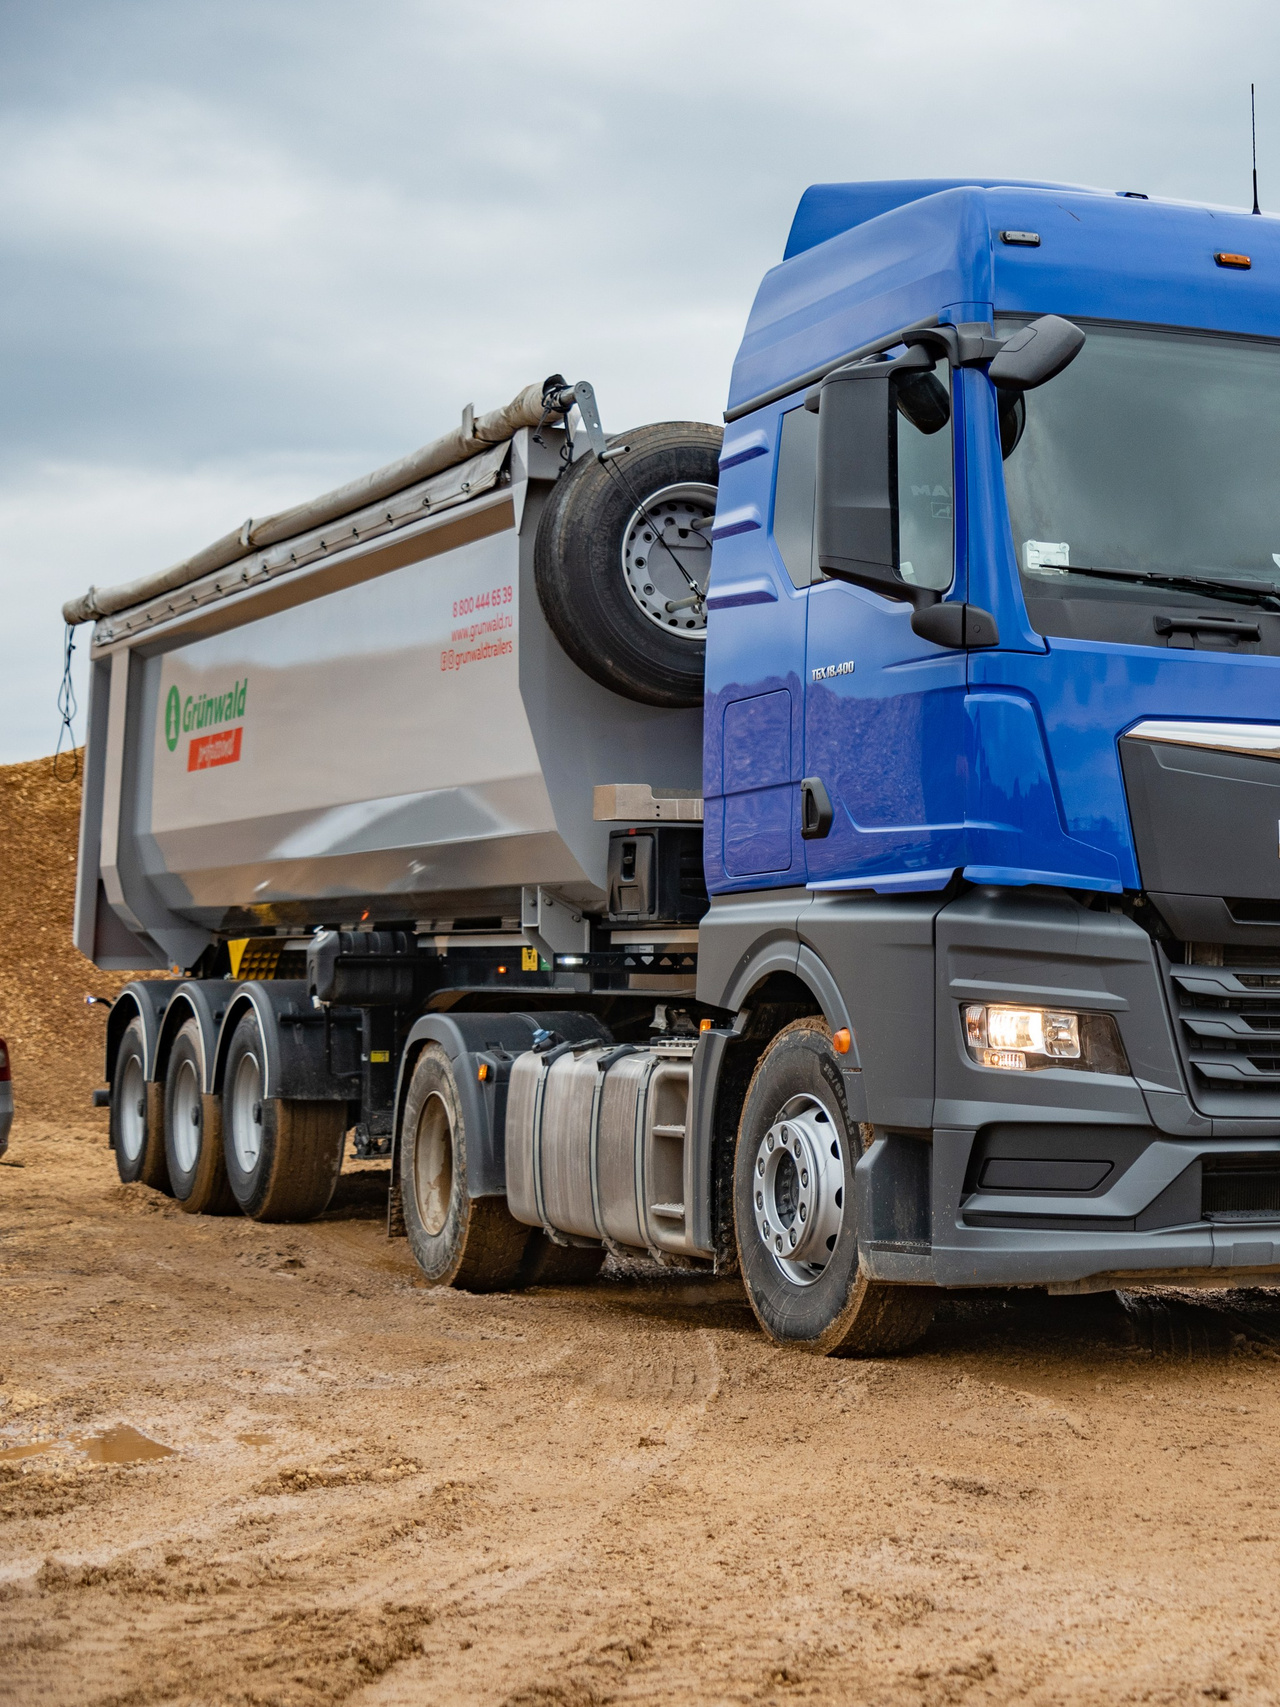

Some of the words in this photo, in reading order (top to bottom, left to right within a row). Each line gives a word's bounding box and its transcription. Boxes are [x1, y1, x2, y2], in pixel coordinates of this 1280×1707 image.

[453, 602, 458, 618] 8
[460, 597, 474, 616] 800
[476, 592, 490, 610] 444
[492, 588, 500, 606] 65
[503, 586, 512, 604] 39
[451, 612, 513, 642] www.grunwald.ru
[827, 661, 854, 678] 18.400
[183, 678, 248, 733] Grünwald
